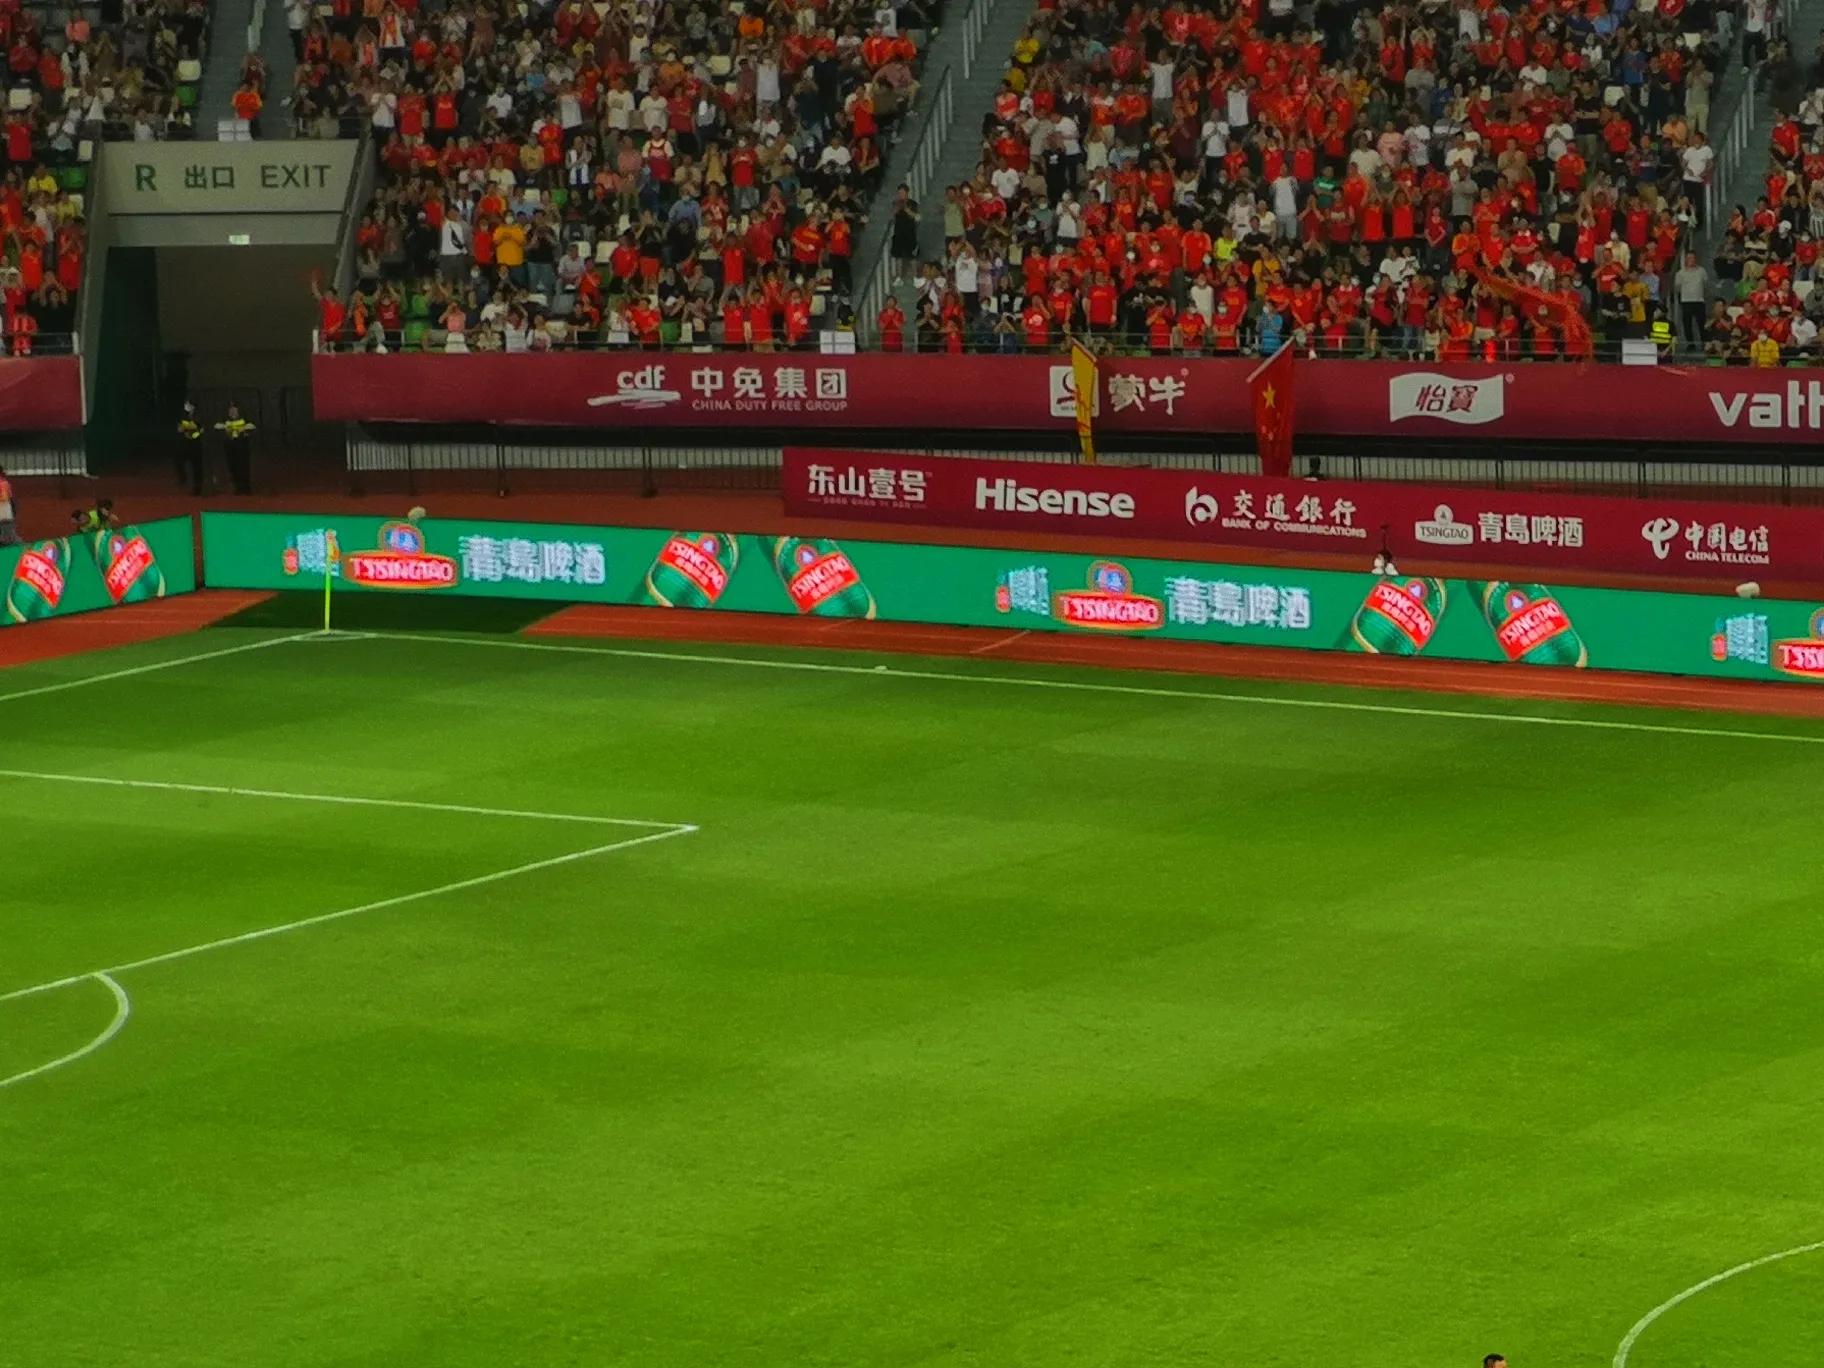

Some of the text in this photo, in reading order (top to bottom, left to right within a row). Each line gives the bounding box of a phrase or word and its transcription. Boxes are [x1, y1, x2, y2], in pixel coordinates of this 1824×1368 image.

[135, 164, 332, 191] R 出口 EXIT
[616, 365, 666, 390] cdf
[691, 366, 848, 400] 中免集团
[692, 400, 848, 411] CHINA DUTY FREE GROUP
[1108, 373, 1186, 416] 蒙牛
[808, 463, 928, 502] 东山壹号
[975, 477, 1136, 519] Hisense
[1222, 517, 1367, 538] BANK OF COMMUNICATIONS
[1419, 525, 1469, 540] TSINGTAO
[1478, 512, 1584, 548] 青島啤酒
[1685, 520, 1769, 554] 中国电信
[1685, 551, 1770, 565] CHINA TELECOM
